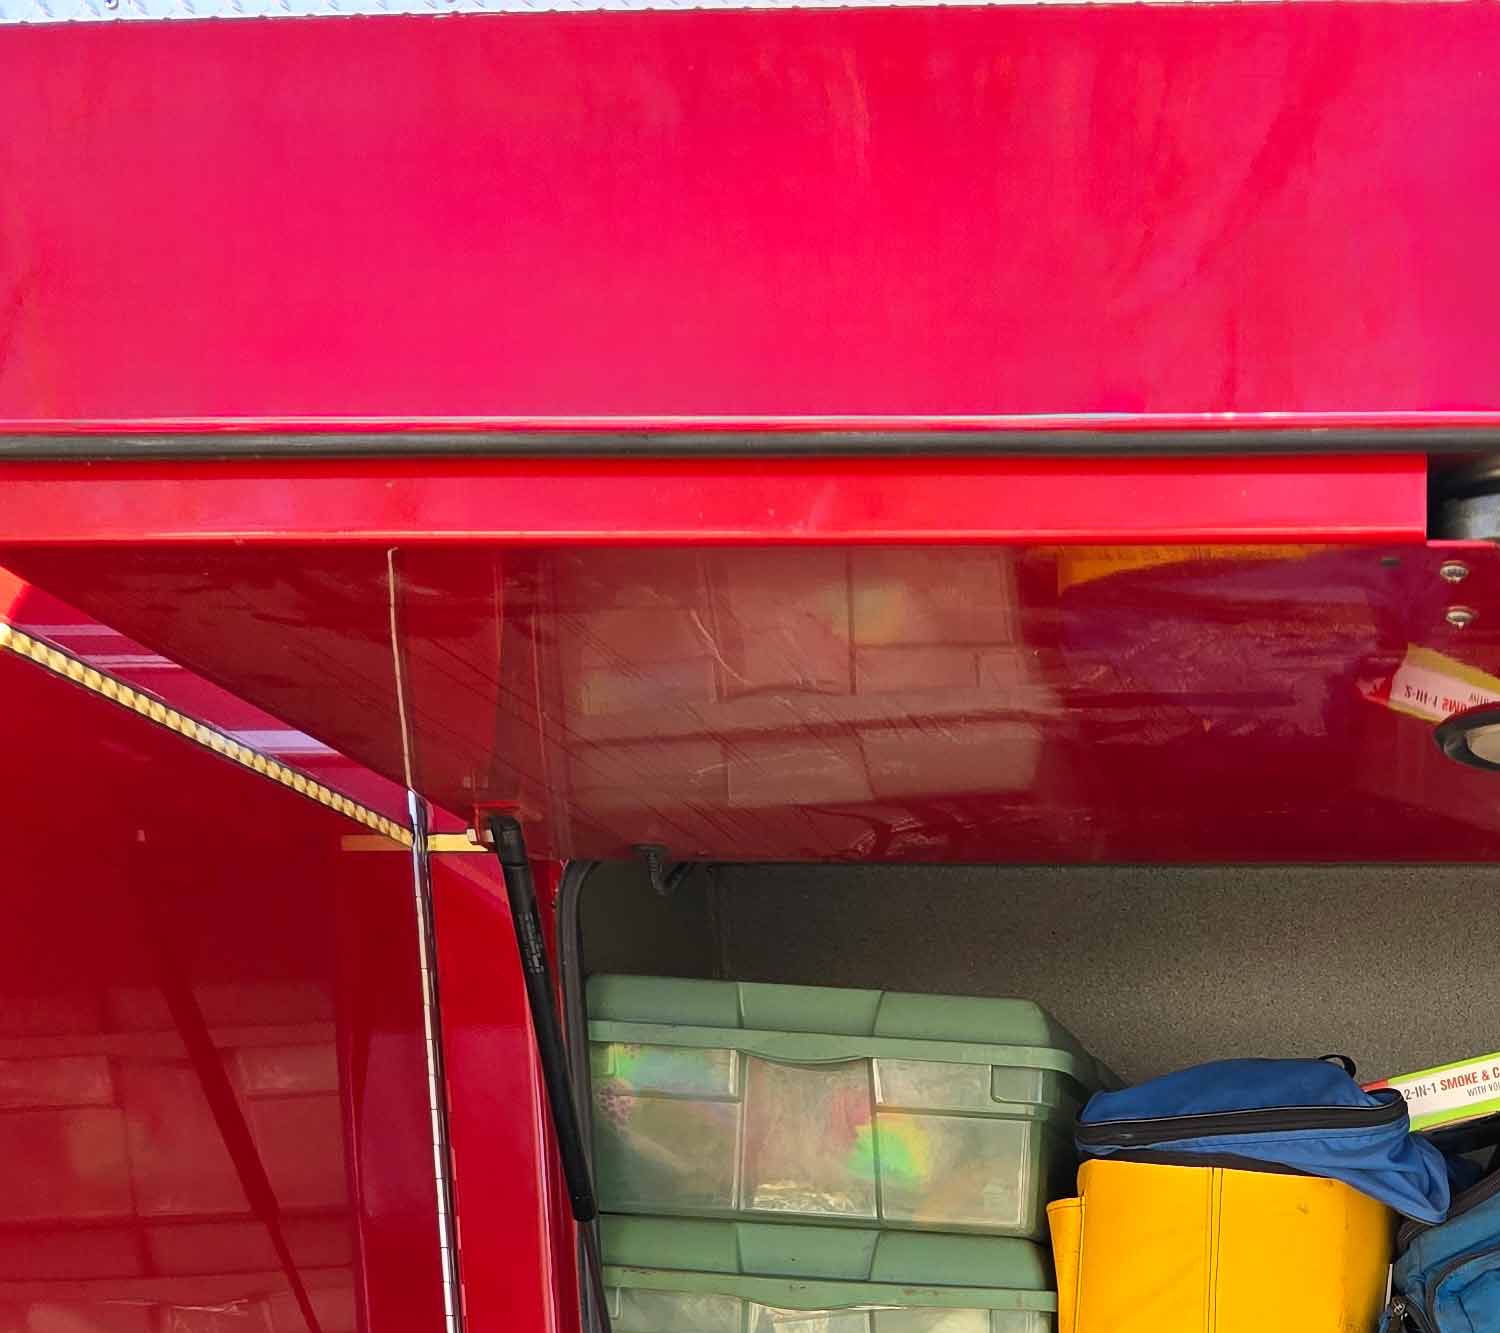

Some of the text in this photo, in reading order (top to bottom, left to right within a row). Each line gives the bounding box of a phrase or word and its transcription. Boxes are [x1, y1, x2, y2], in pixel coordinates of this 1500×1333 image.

[1404, 1082, 1437, 1101] 2-IN-1
[1440, 1071, 1478, 1091] SMOKE
[1481, 1069, 1490, 1081] &
[1467, 1084, 1486, 1097] WITH
